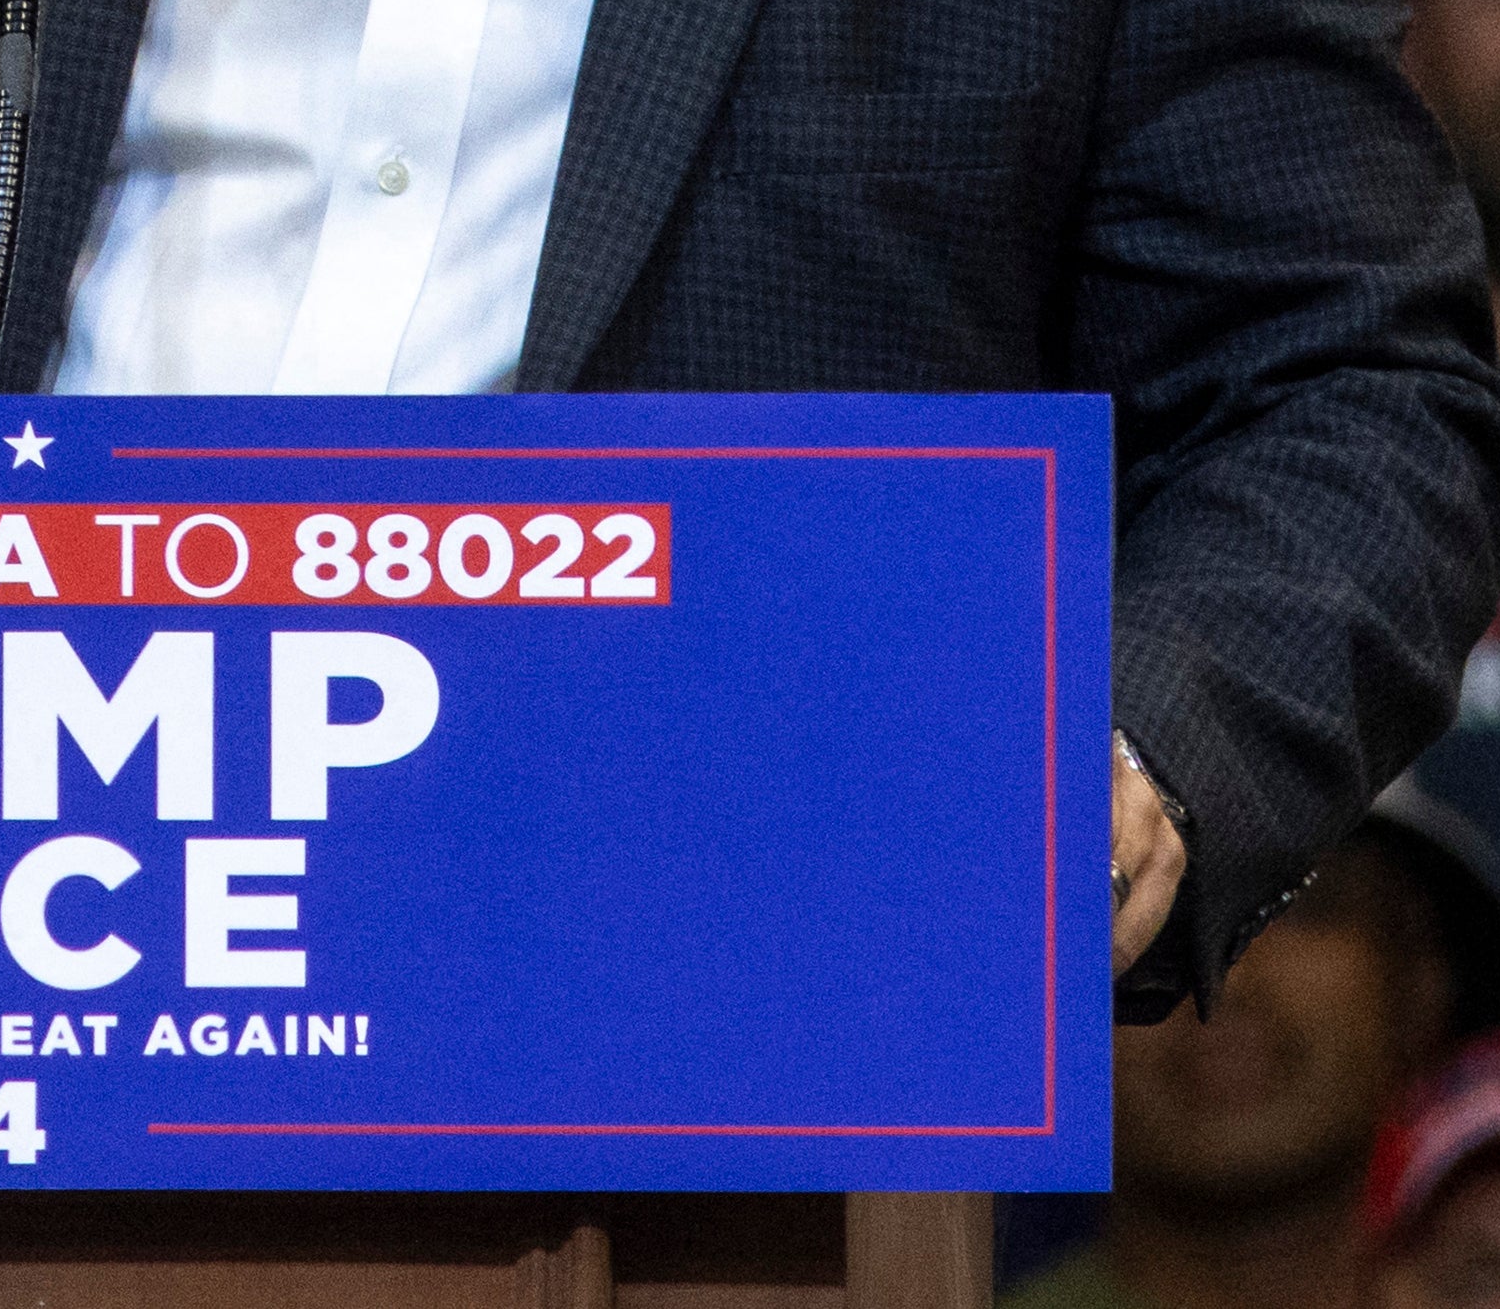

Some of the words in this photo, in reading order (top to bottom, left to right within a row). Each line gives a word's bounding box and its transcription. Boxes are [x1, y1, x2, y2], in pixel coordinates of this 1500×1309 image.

[95, 513, 249, 598] TO
[292, 513, 656, 598] 88022
[144, 1014, 368, 1056] AGAIN!
